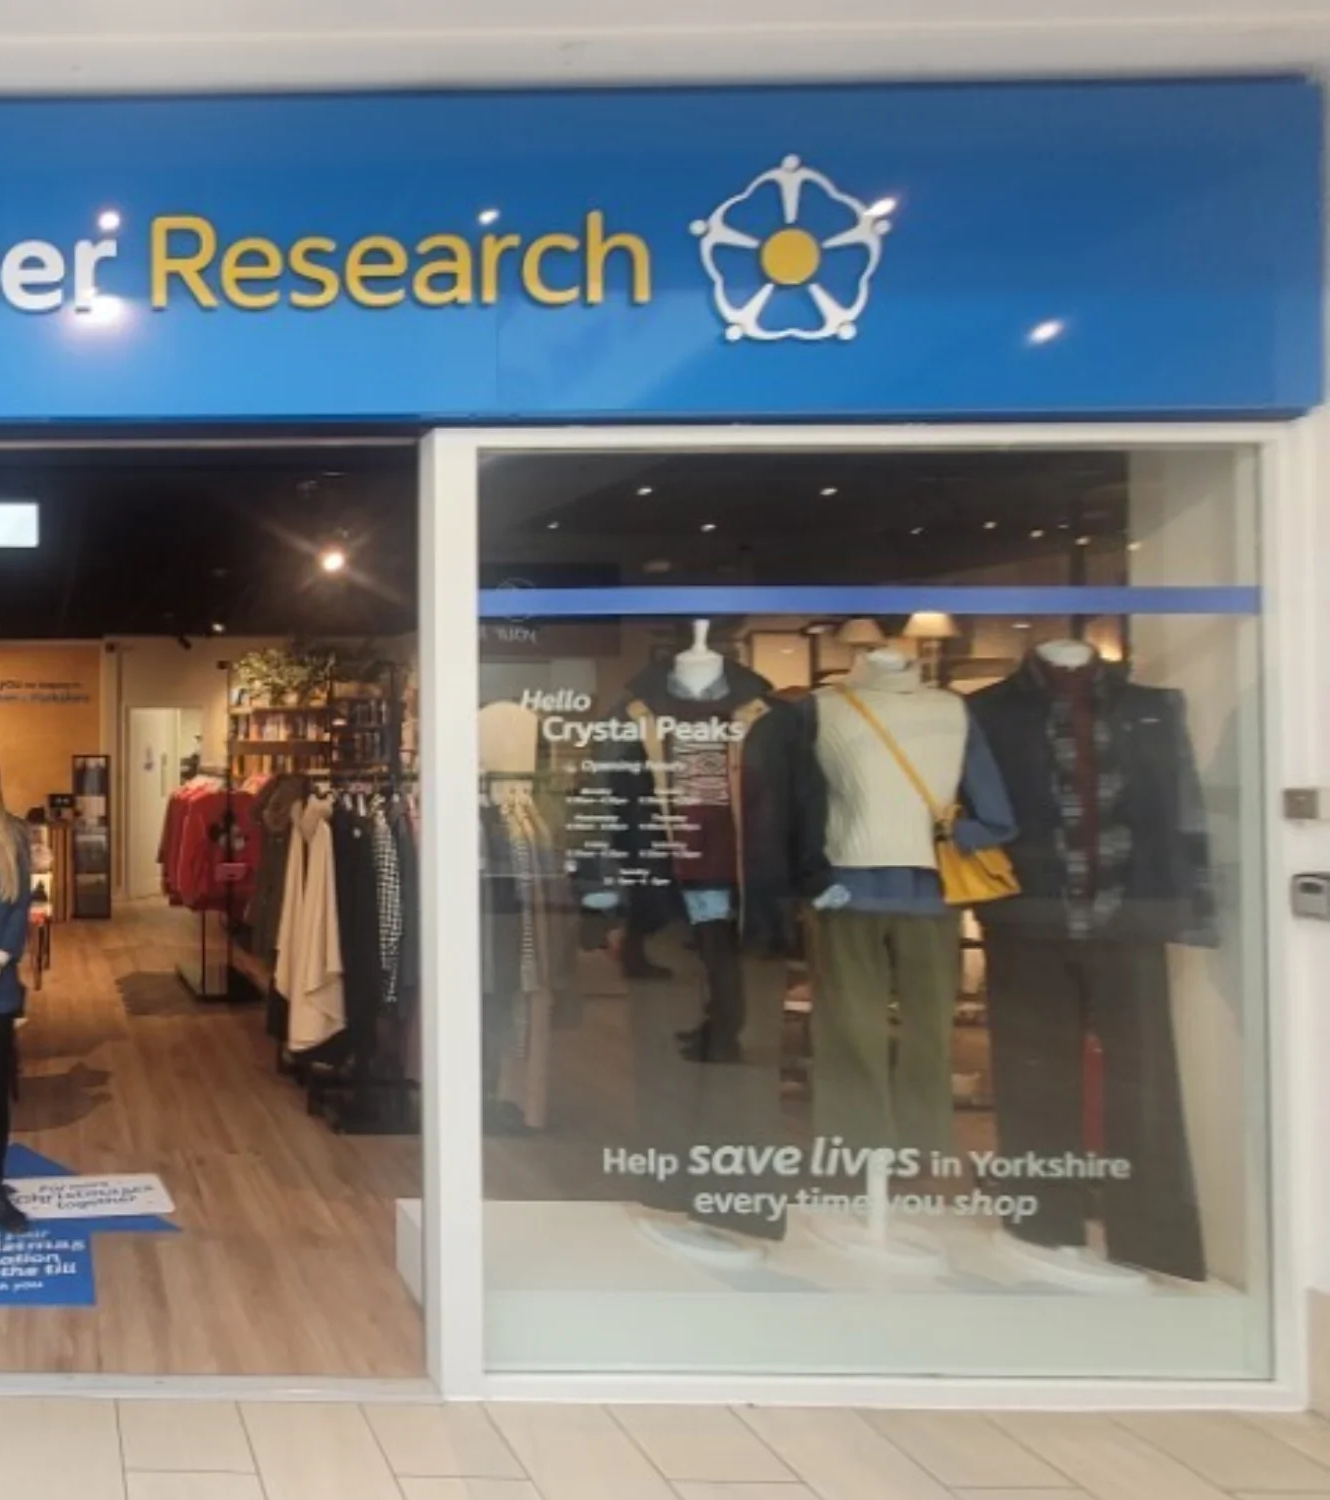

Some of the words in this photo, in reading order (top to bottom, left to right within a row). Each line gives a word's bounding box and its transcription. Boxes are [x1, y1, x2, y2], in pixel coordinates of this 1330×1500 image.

[151, 211, 652, 308] Research
[520, 688, 592, 713] Hello
[542, 715, 647, 748] Crystal
[655, 716, 746, 742] Peaks
[603, 1148, 680, 1181] Help
[687, 1144, 801, 1177] save
[811, 1136, 920, 1178] lives
[931, 1149, 962, 1179] in
[968, 1150, 1131, 1180] Yorkshire
[694, 1189, 788, 1222] every
[793, 1188, 870, 1214] time
[954, 1189, 1039, 1224] shop
[0, 1263, 40, 1279] the
[44, 1261, 78, 1276] till
[13, 1279, 46, 1293] you
